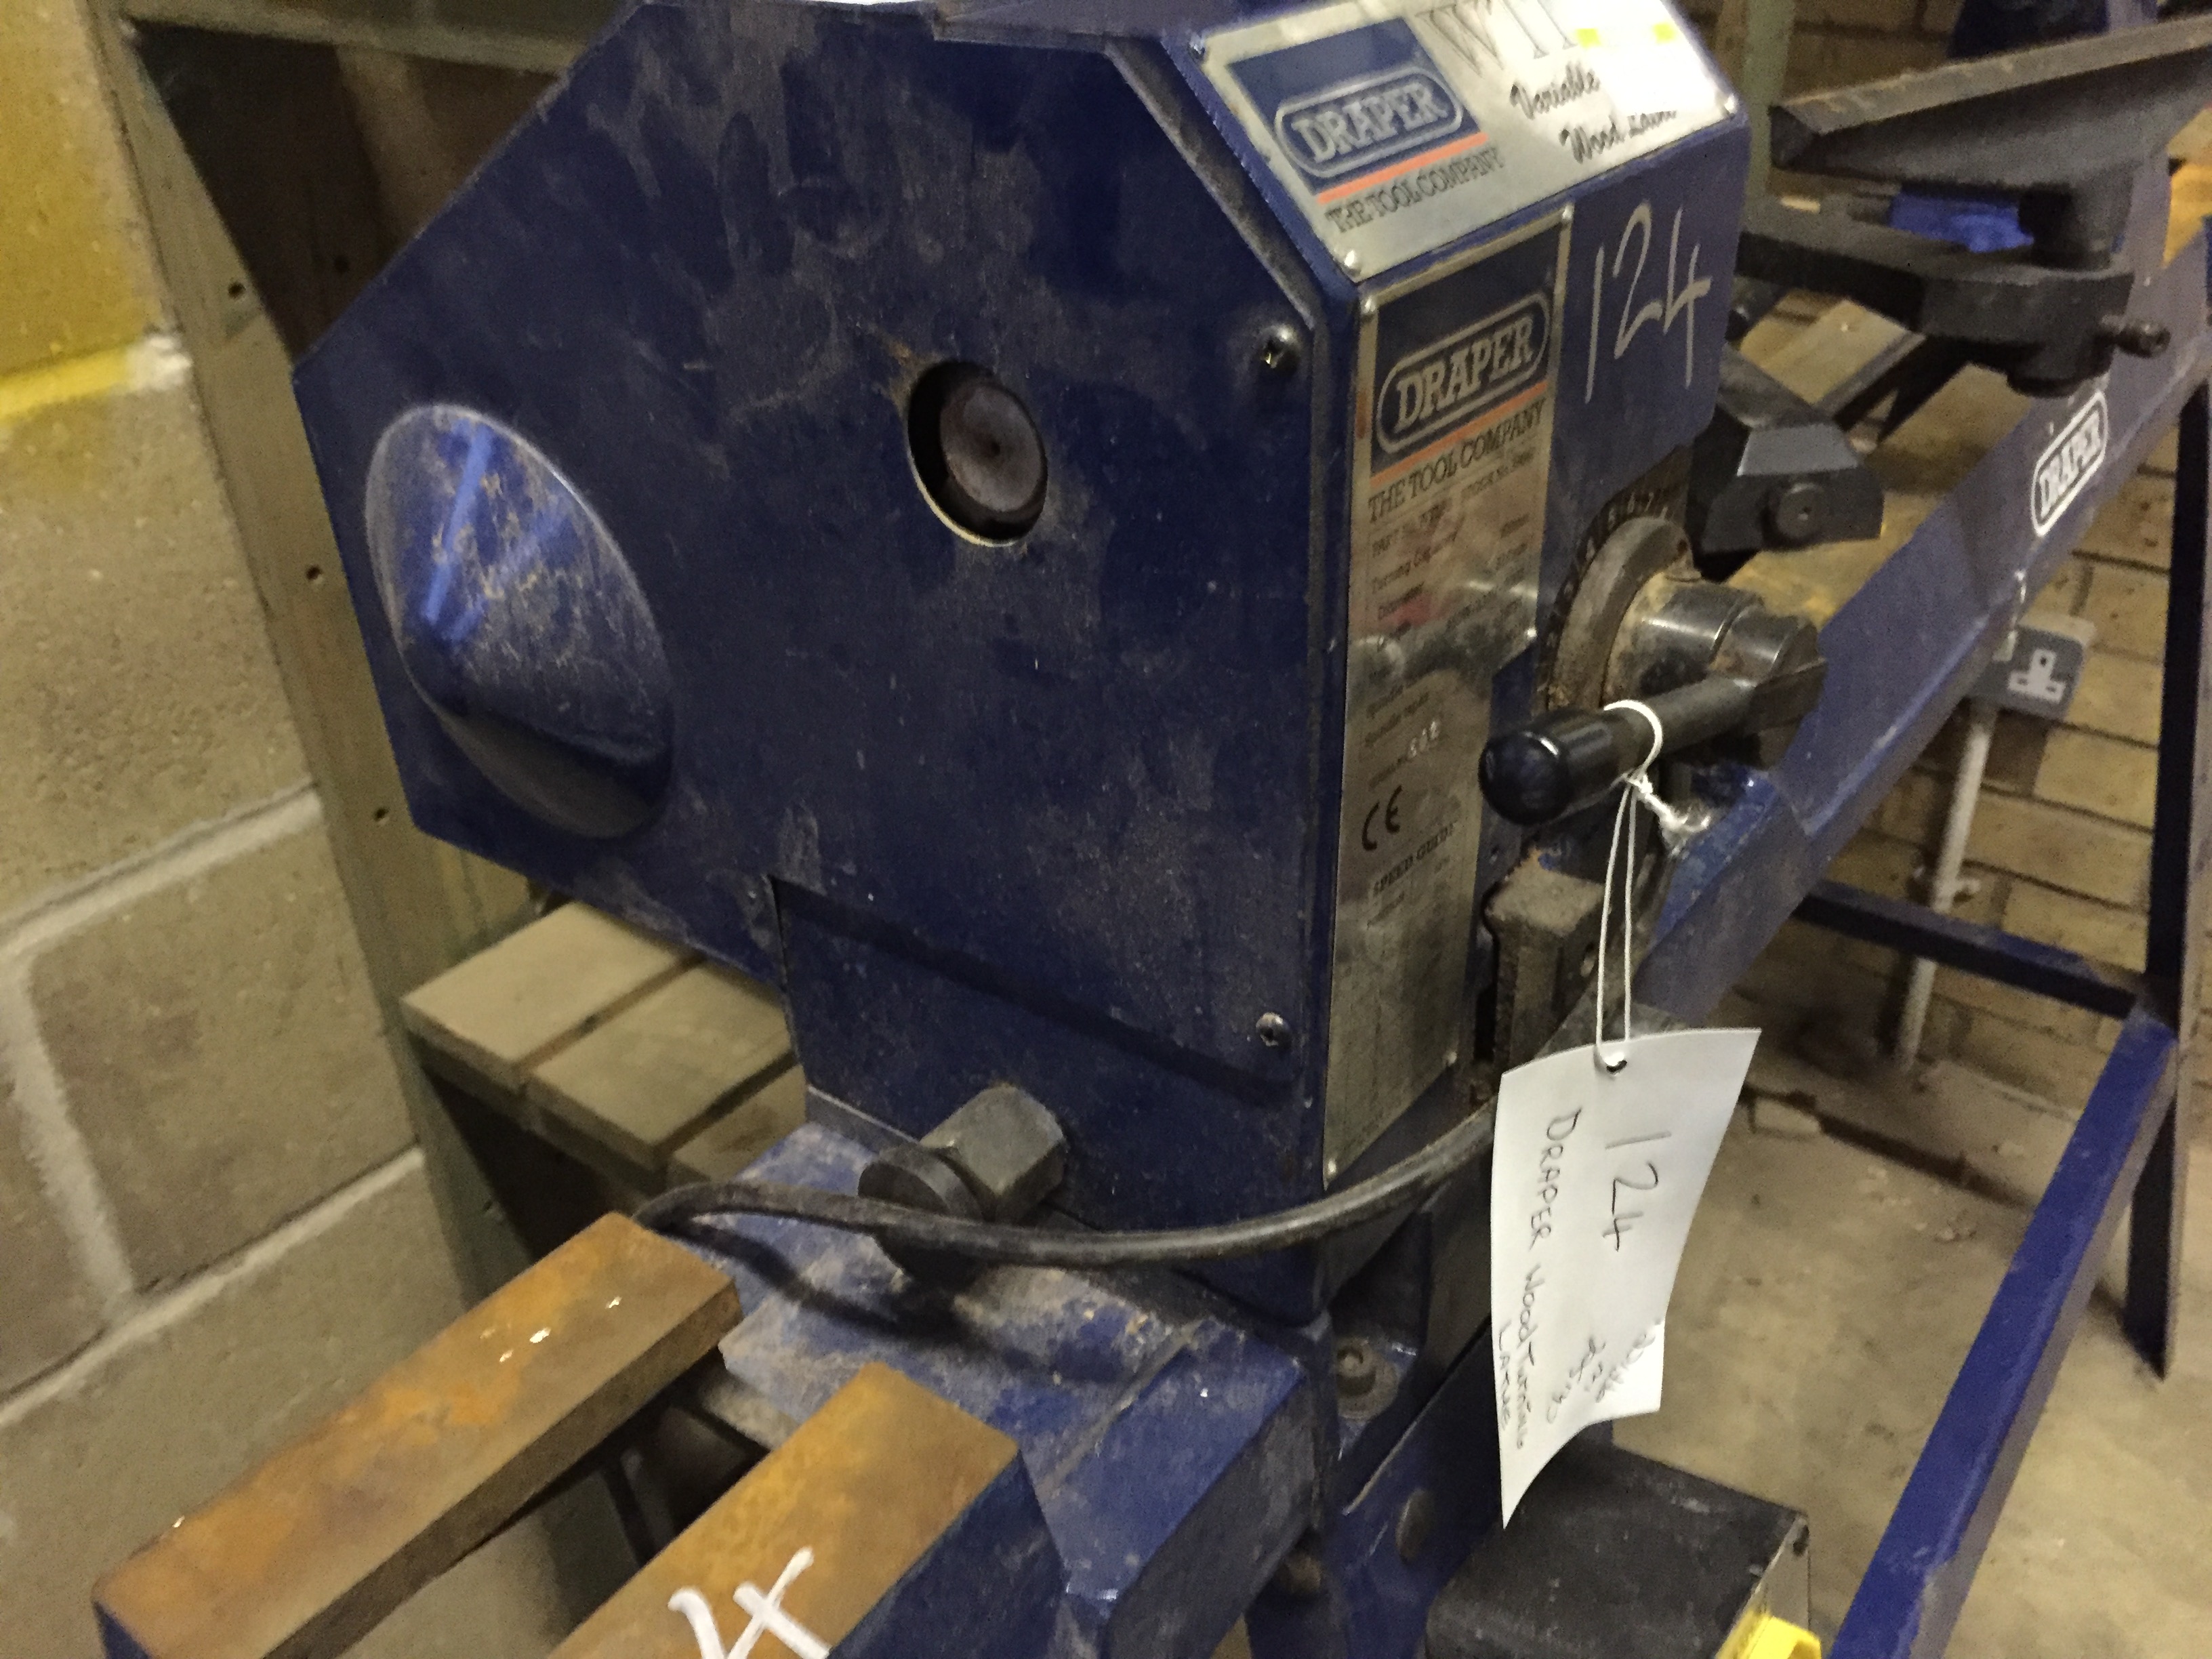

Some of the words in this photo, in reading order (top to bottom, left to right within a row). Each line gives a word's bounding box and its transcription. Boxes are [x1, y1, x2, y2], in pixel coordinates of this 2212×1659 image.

[1290, 82, 1448, 163] DRAPER
[1559, 113, 1625, 164] Wood
[1324, 199, 1373, 232] THE
[1367, 180, 1422, 217] TOOL
[1416, 147, 1504, 196] COMPANY
[1584, 202, 1713, 405] 124
[1393, 314, 1536, 434] DRAPER
[1368, 477, 1406, 523] THE
[1408, 448, 1457, 499] TOOL
[1460, 397, 1548, 469] COMPANY
[2039, 410, 2101, 519] DRAPER
[1361, 785, 1403, 851] CE
[1529, 1107, 1583, 1250] DRAPER
[1602, 1131, 1673, 1252] 124
